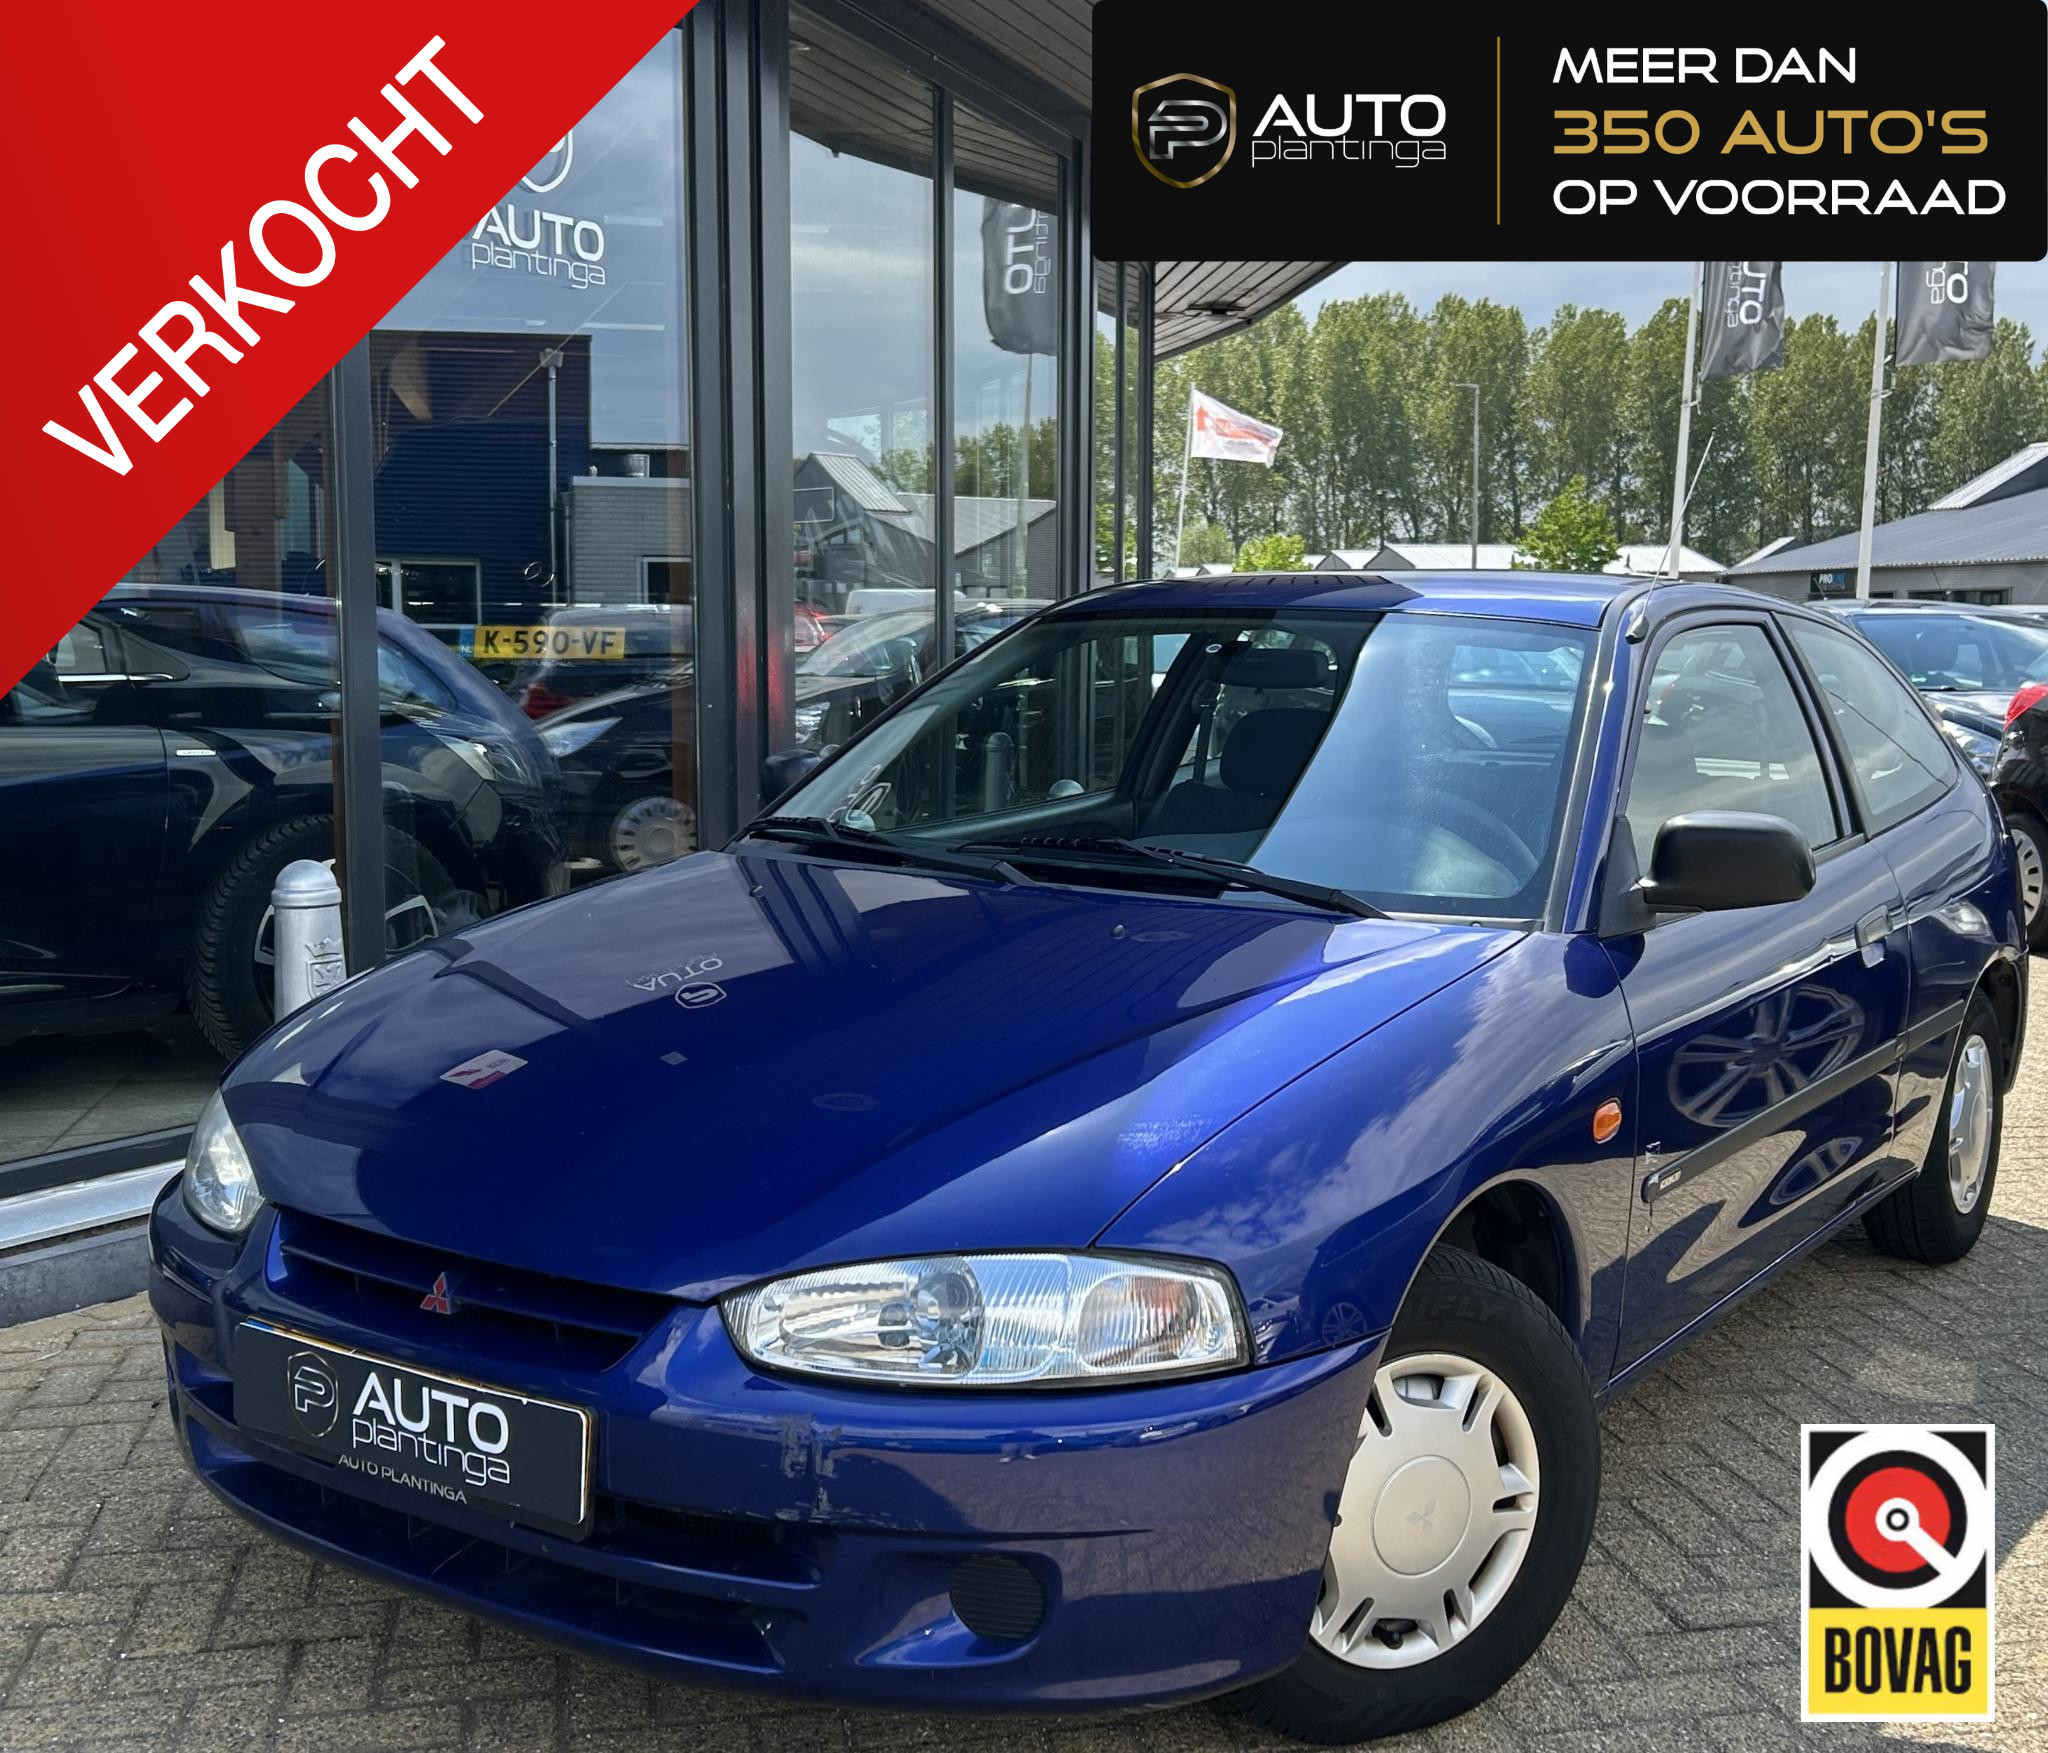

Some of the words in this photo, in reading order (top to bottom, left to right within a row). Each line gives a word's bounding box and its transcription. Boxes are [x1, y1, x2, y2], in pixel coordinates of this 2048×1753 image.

[472, 204, 604, 262] AUTO
[472, 241, 605, 289] plantinga
[484, 629, 617, 655] K-590-VF
[353, 1372, 509, 1454] AUTO
[338, 1454, 379, 1475] AUTO
[381, 1465, 467, 1504] PLANTINGA
[352, 1418, 511, 1486] plantinga
